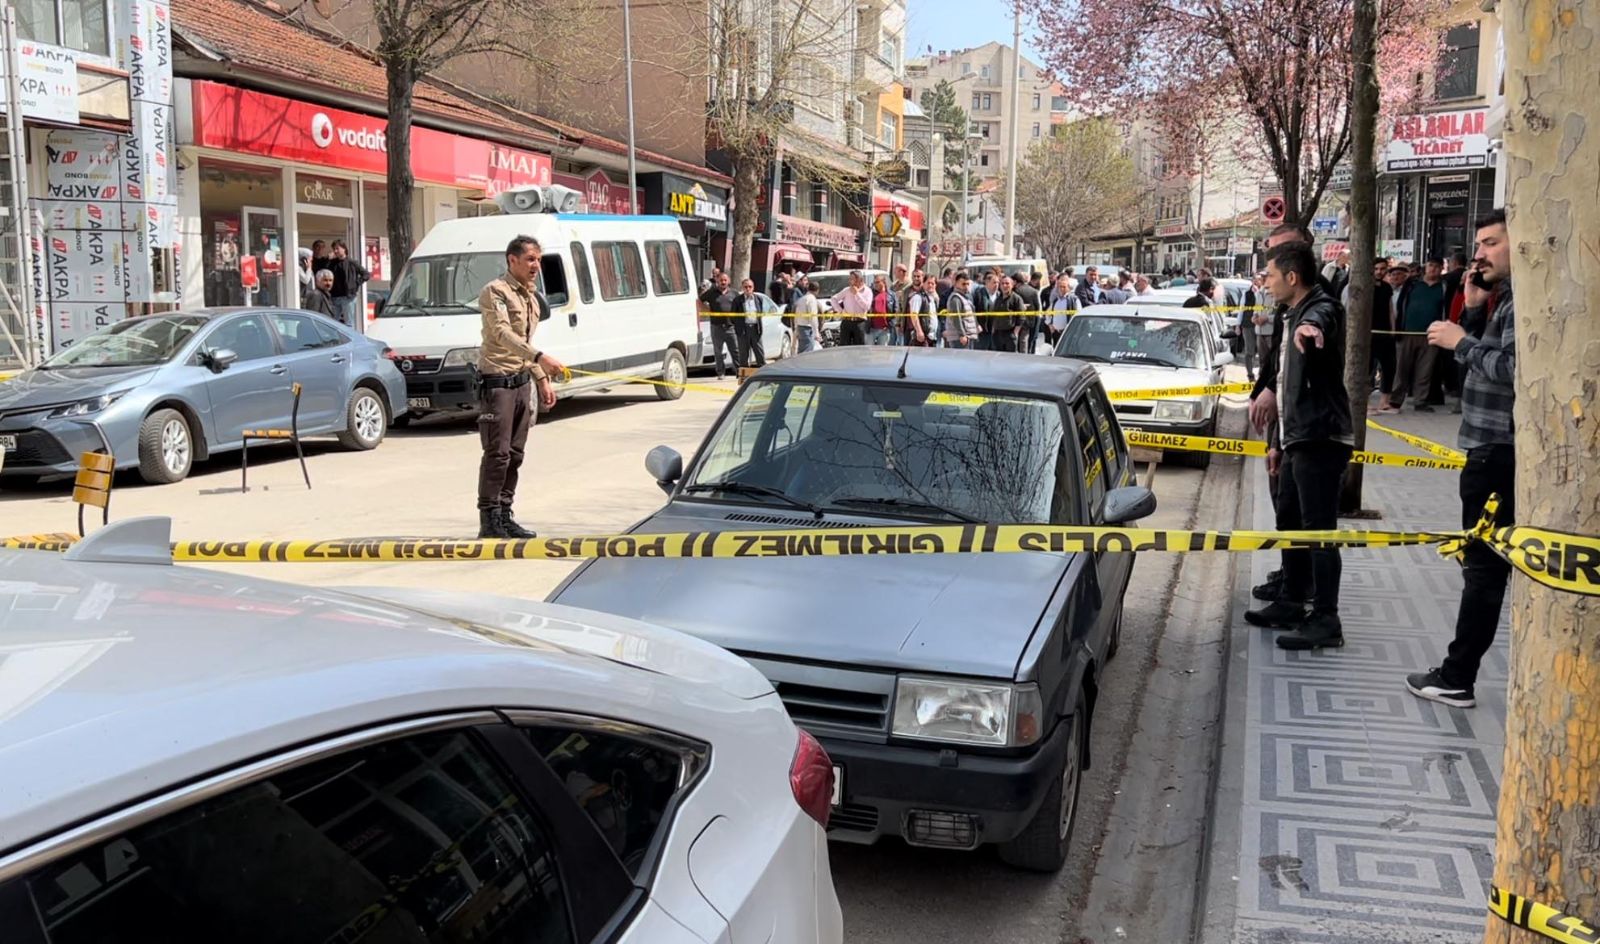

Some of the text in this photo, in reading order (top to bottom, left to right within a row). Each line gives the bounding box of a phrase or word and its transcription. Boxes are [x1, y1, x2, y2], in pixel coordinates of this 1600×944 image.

[155, 21, 168, 67] AKPA
[20, 77, 48, 96] KPA
[131, 50, 145, 98] AKPA
[153, 107, 164, 152] AKPA
[338, 127, 387, 151] vodafo
[1392, 112, 1485, 140] ASLANLAR
[126, 136, 139, 183] AKPA
[50, 183, 100, 198] AKPA
[670, 191, 695, 215] ANT
[88, 219, 103, 265] AKPA
[148, 221, 159, 245] AK
[53, 253, 69, 299] AKPA
[1207, 439, 1244, 452] POLİS
[1404, 458, 1464, 470] GİRİLME
[1522, 536, 1600, 587] GİR
